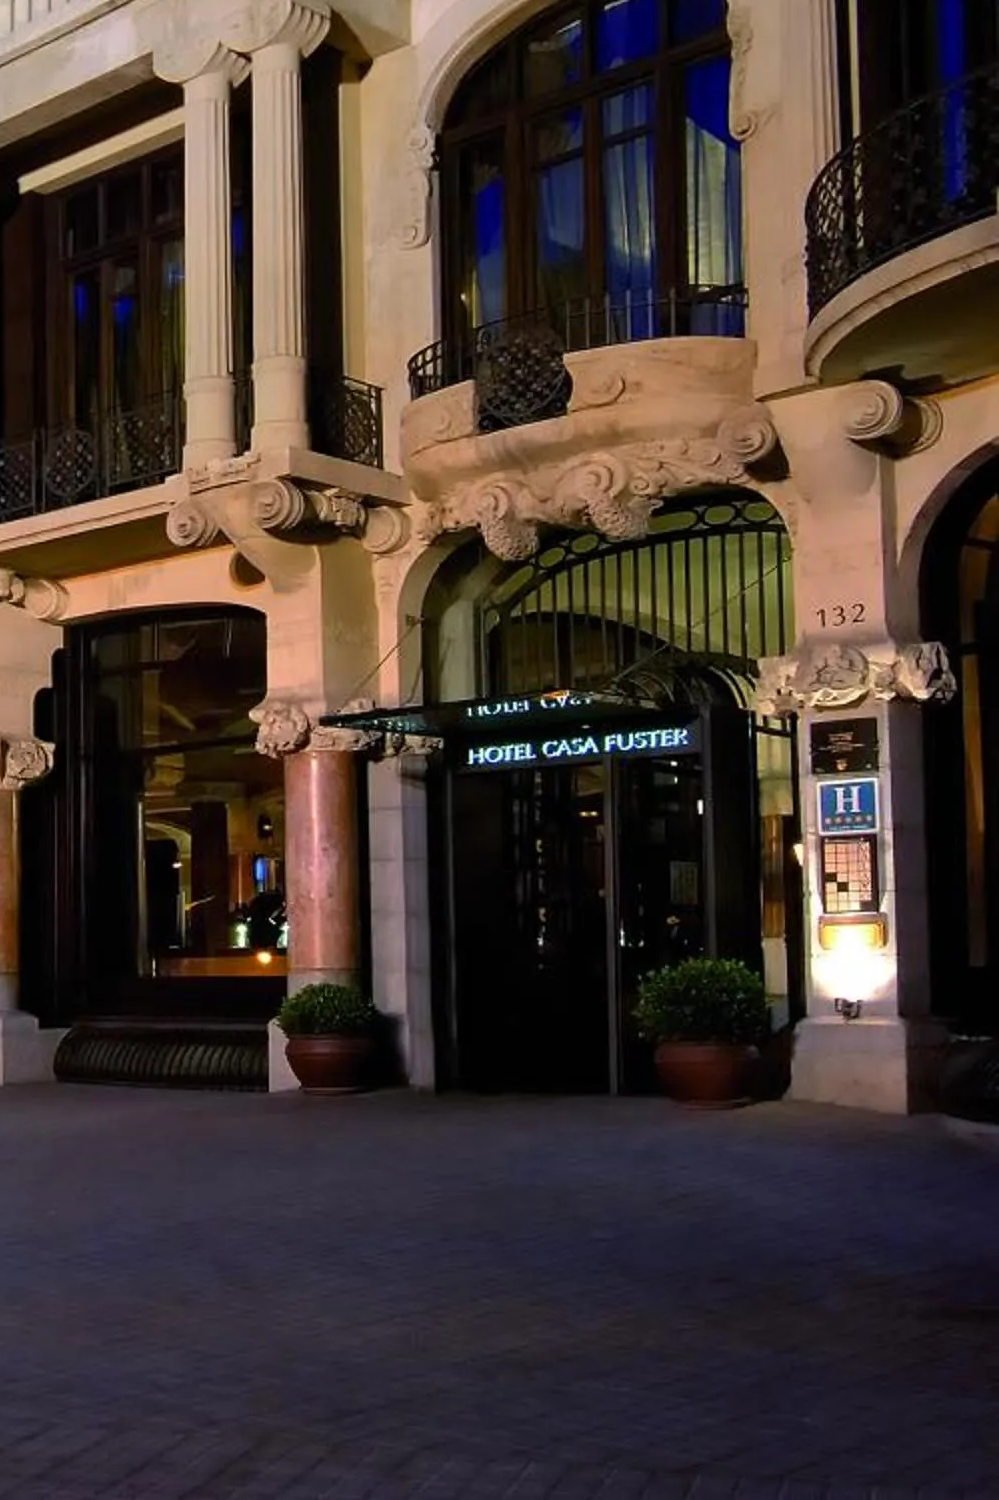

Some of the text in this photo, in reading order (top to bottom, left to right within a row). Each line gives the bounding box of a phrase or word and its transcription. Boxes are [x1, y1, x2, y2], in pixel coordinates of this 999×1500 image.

[816, 603, 866, 628] 132
[468, 728, 688, 765] HOTEL CASA FUSTER
[834, 785, 861, 814] H
